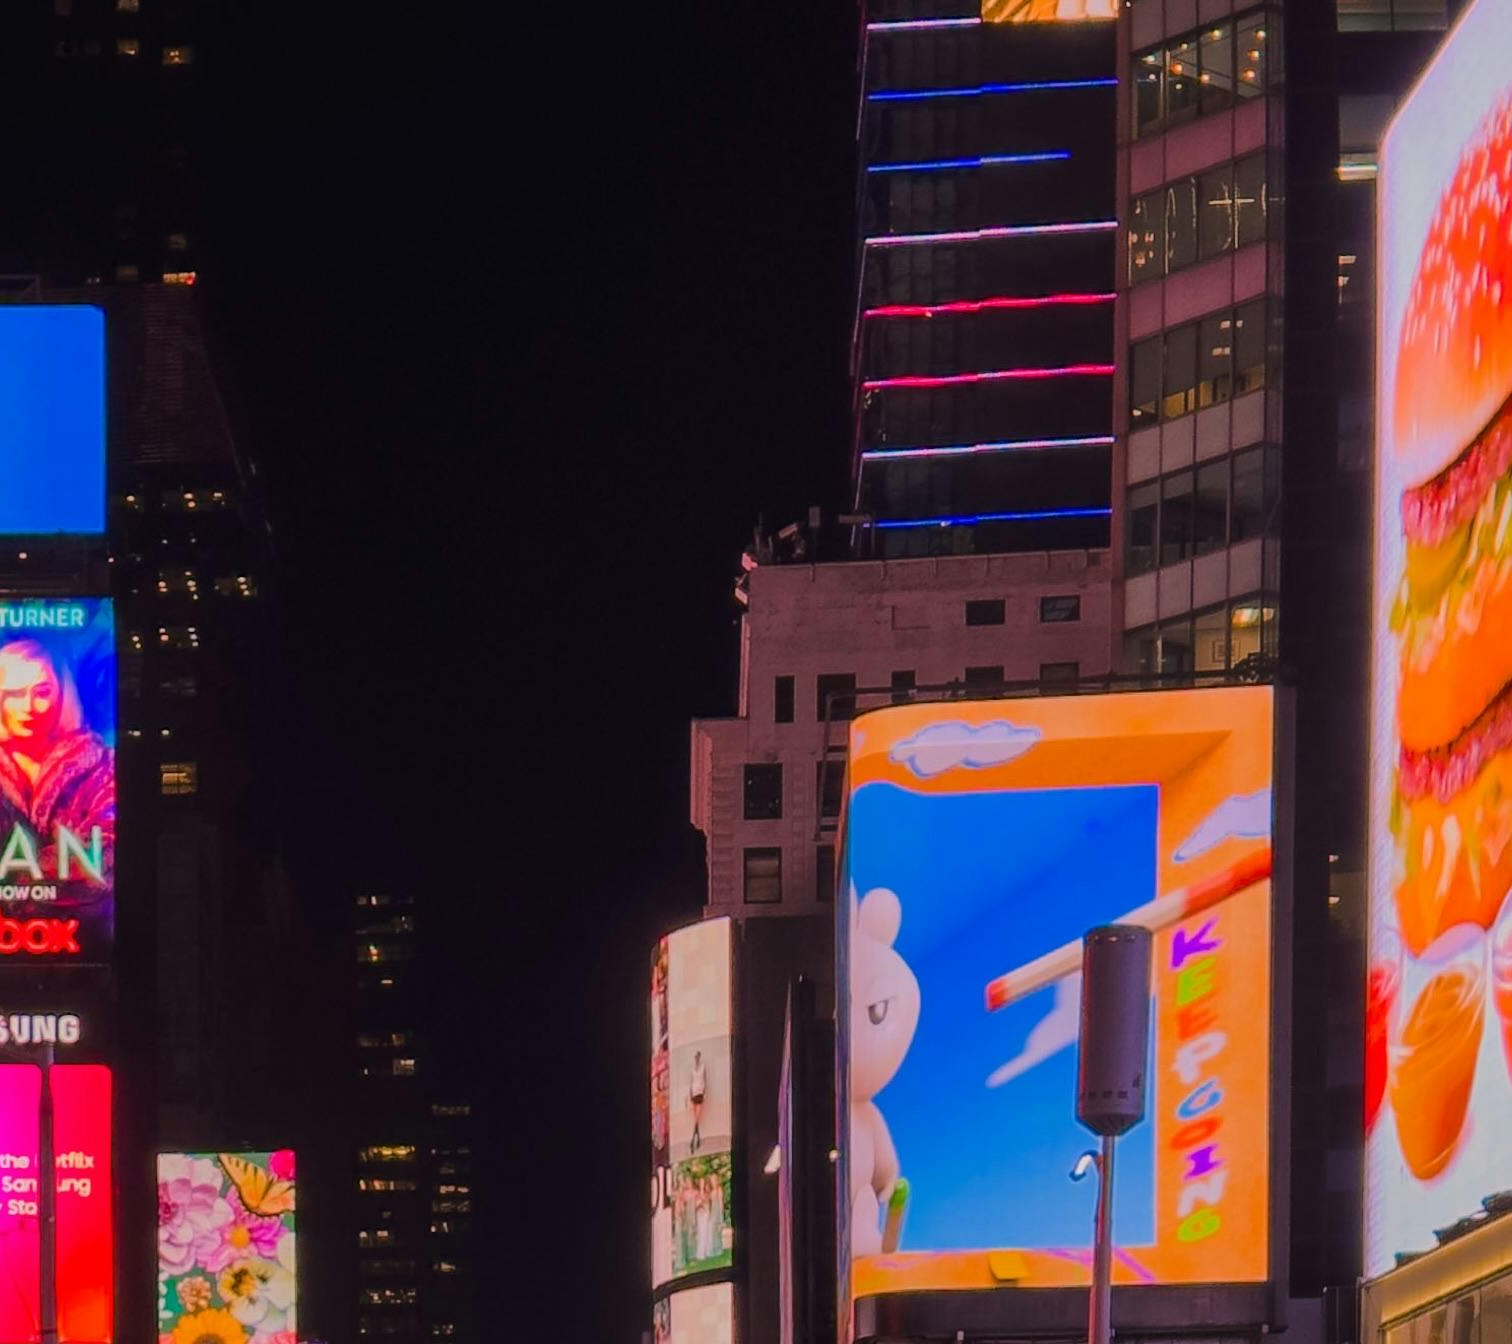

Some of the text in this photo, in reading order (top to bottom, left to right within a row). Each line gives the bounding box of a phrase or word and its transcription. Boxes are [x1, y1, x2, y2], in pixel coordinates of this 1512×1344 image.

[31, 886, 56, 900] ON
[34, 1152, 94, 1169] tflix
[7, 1199, 38, 1215] Sto
